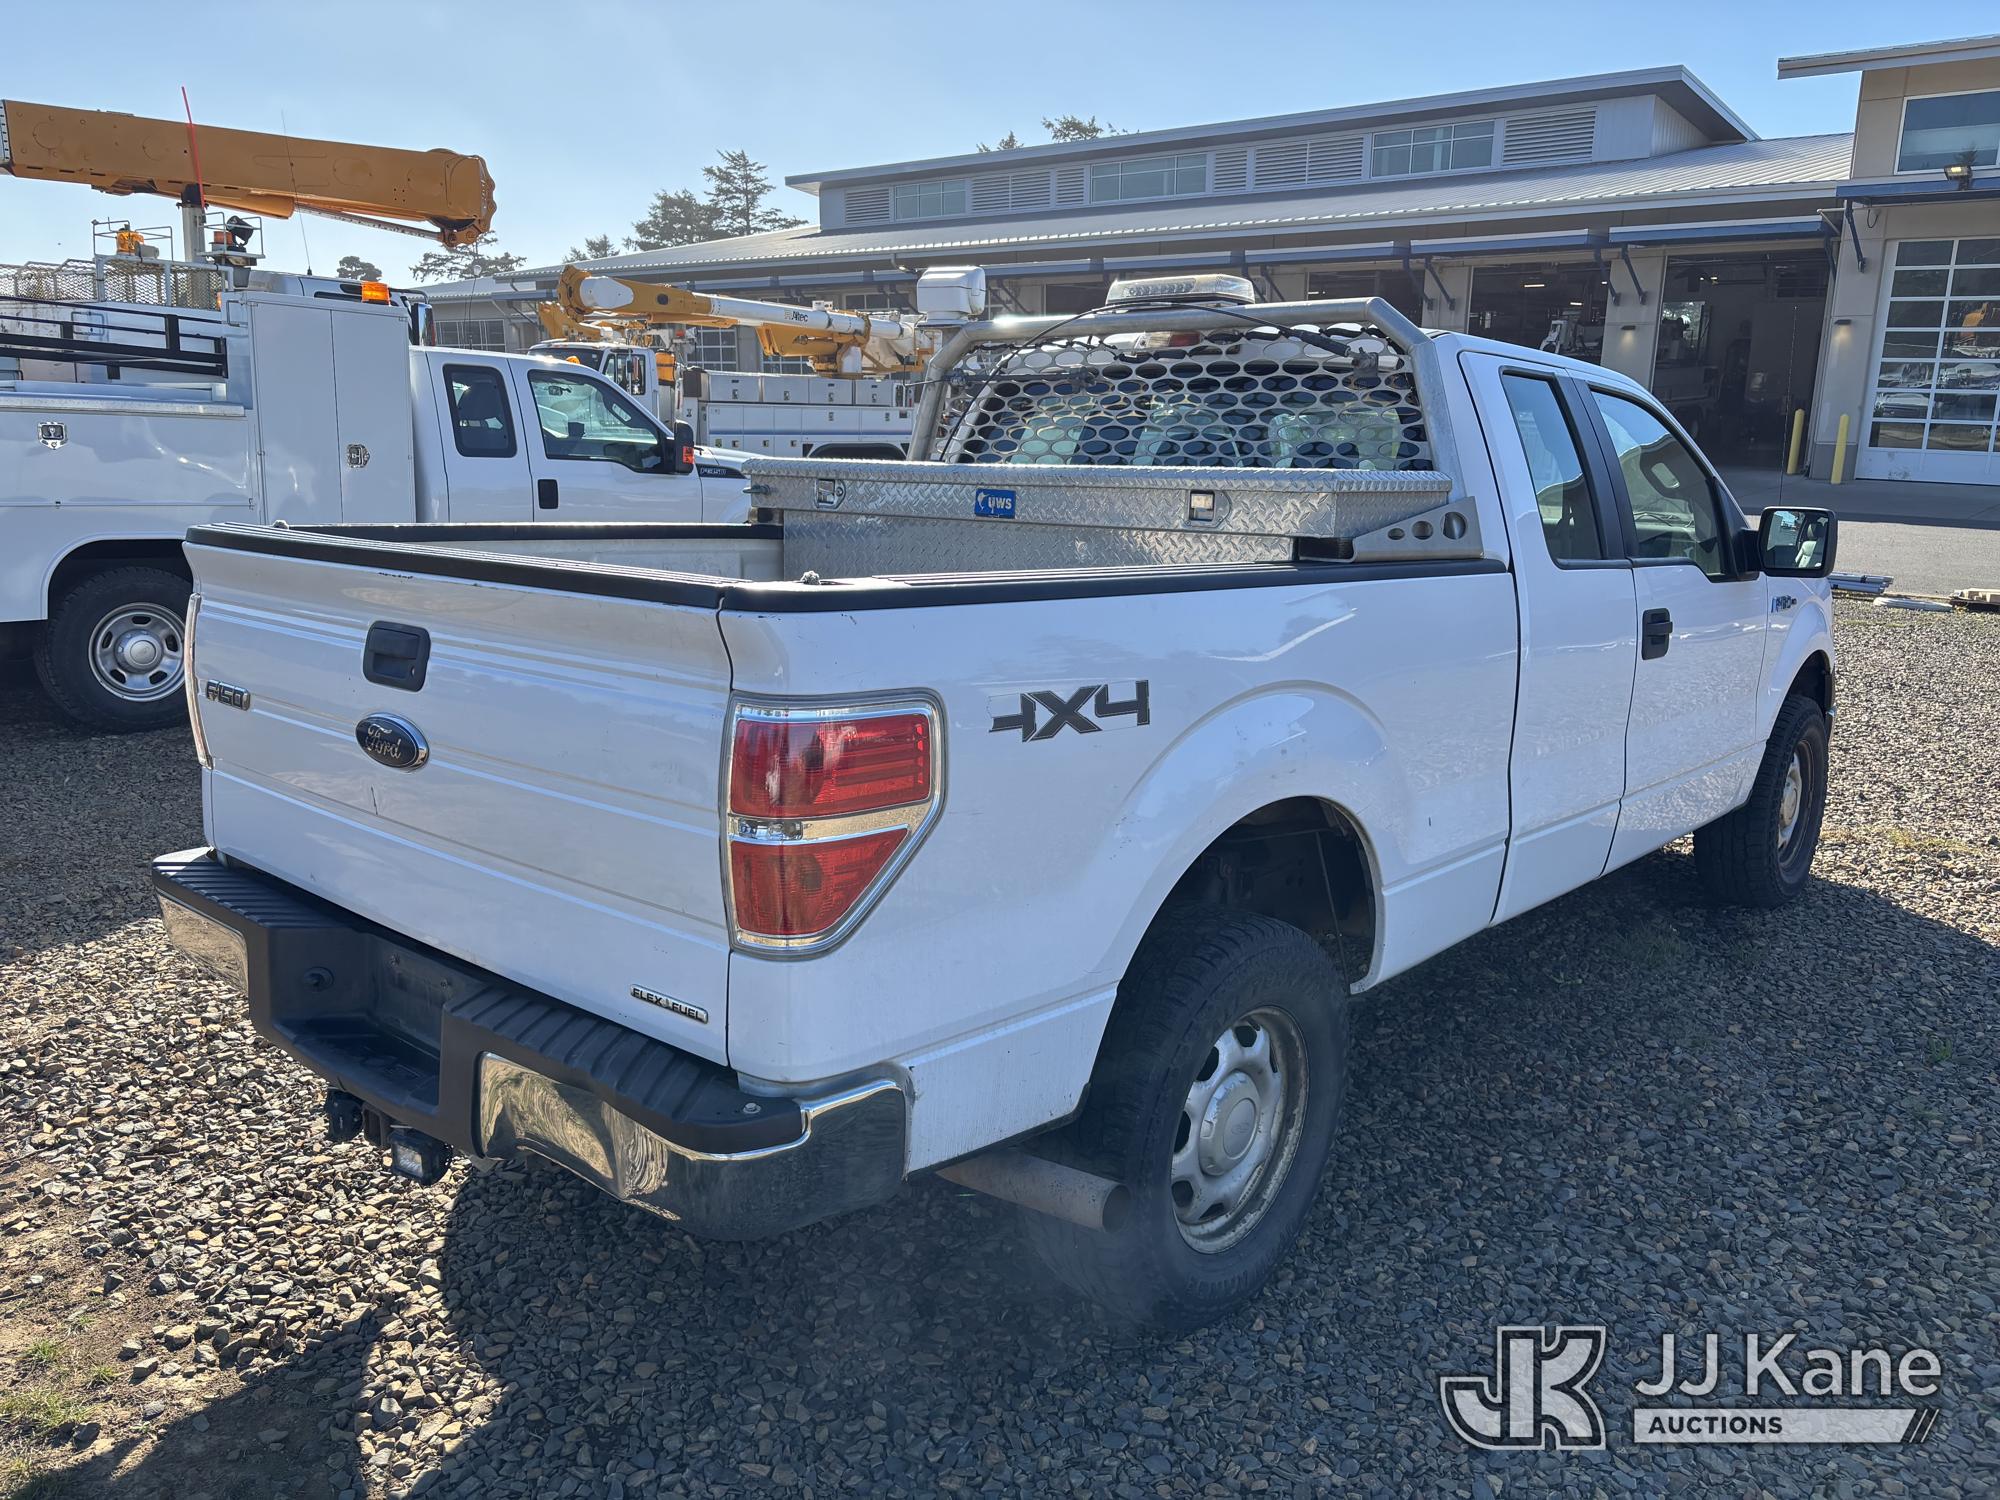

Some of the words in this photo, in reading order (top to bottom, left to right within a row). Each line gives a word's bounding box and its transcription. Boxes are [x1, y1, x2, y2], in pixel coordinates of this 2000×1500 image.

[791, 310, 809, 322] Altec
[987, 496, 1012, 510] UWS
[365, 722, 402, 759] Ford
[632, 987, 662, 1007] FLEX
[671, 1002, 705, 1022] FUEL
